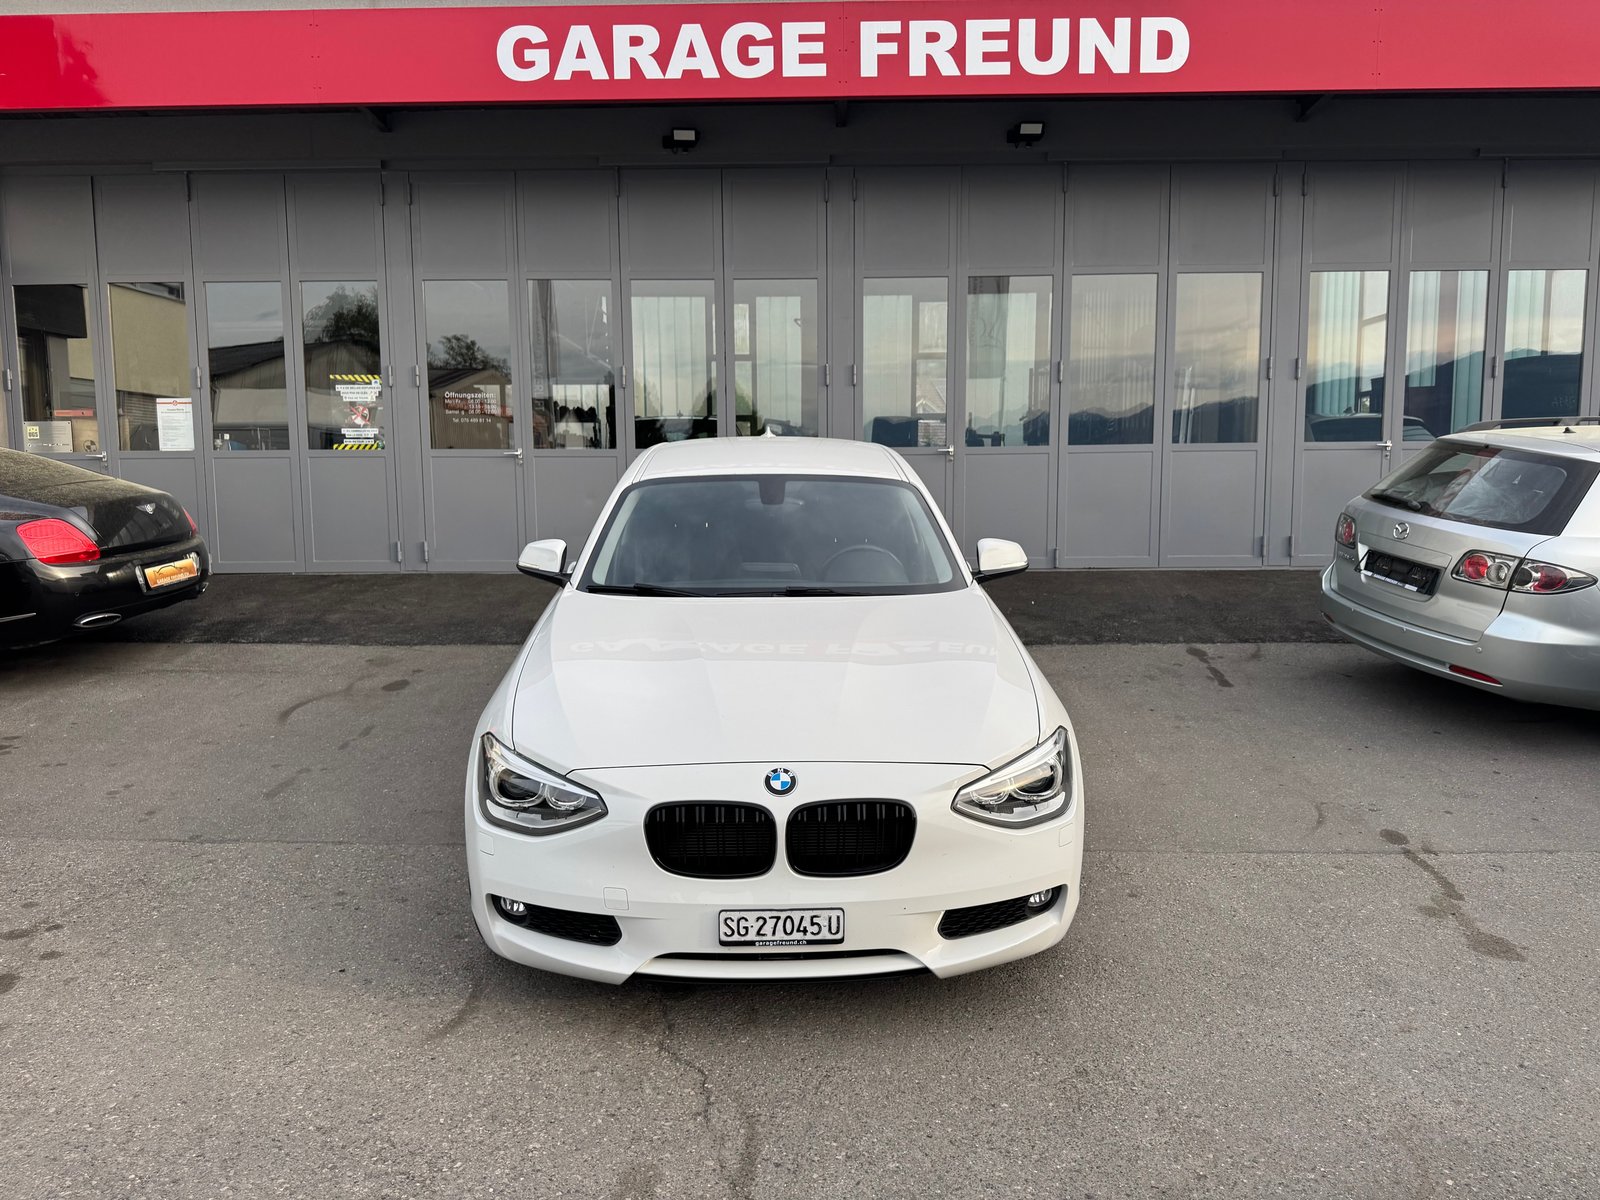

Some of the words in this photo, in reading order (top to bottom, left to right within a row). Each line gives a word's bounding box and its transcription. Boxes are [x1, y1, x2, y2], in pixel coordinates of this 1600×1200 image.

[496, 22, 826, 82] GARAGE
[860, 15, 1190, 78] FREUND
[444, 391, 497, 399] Öffnungszeiten:
